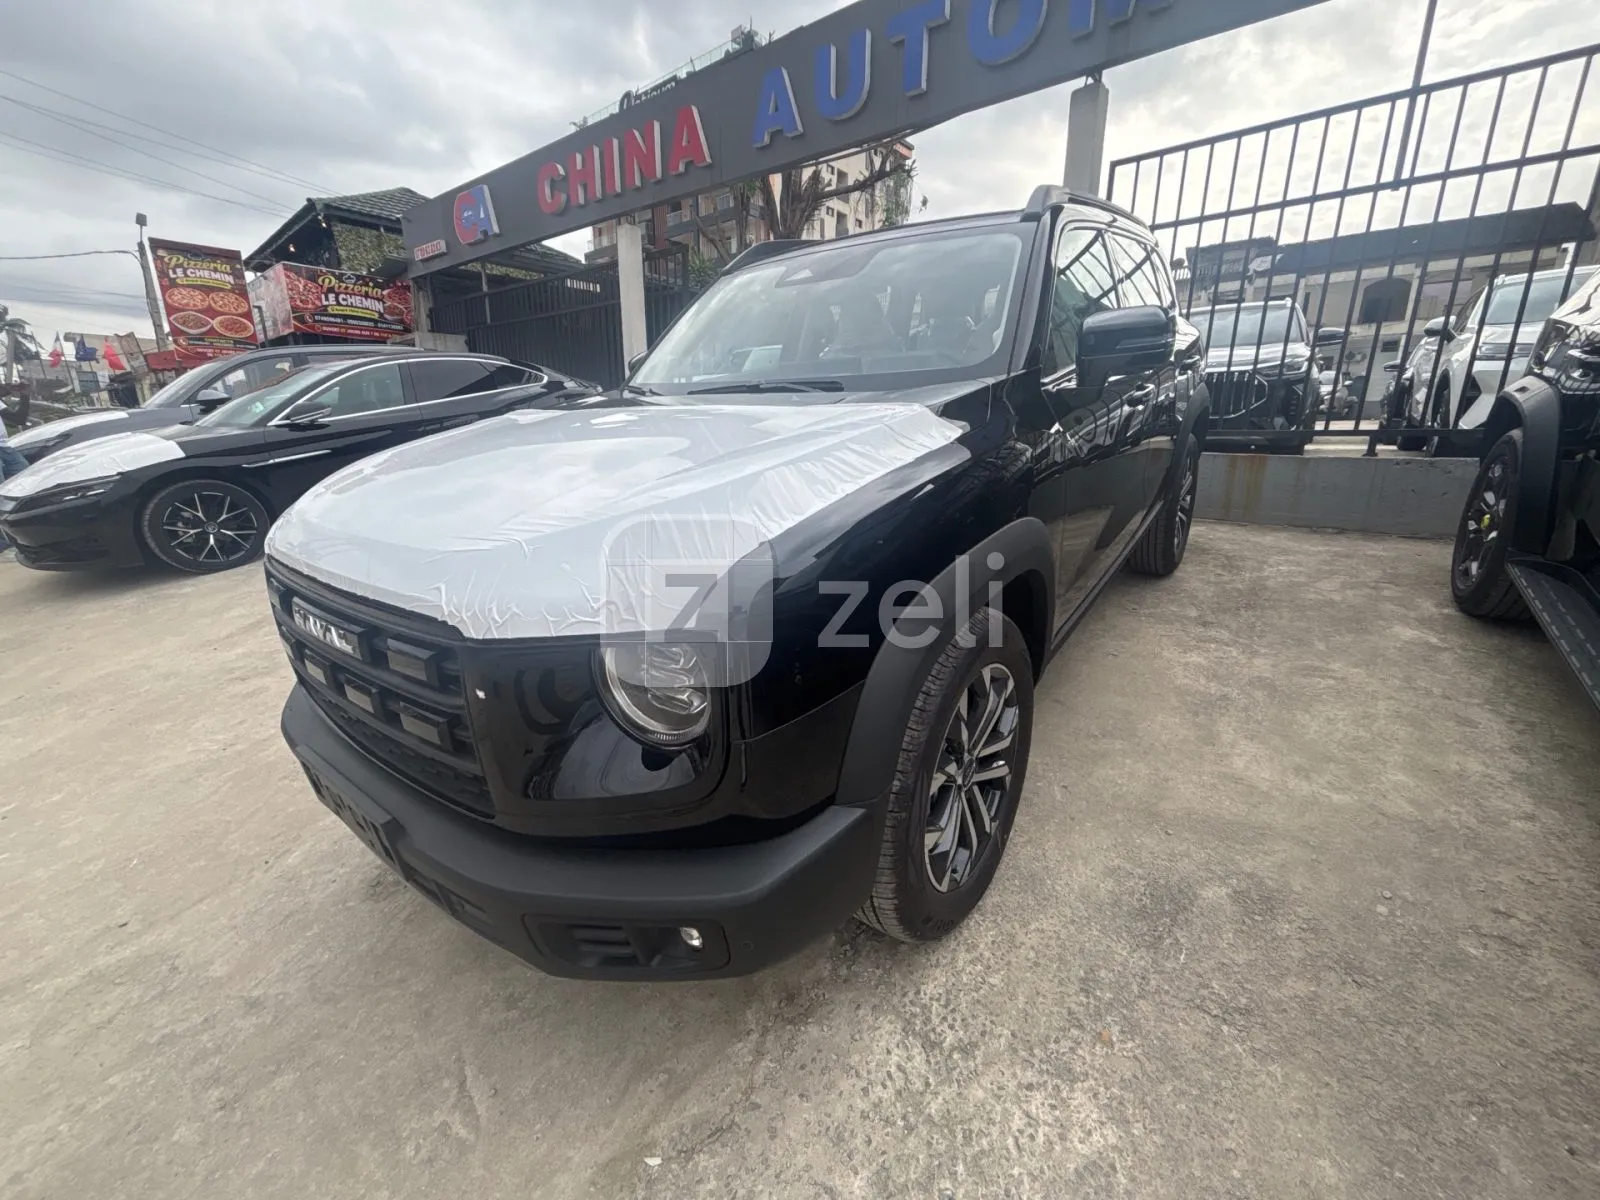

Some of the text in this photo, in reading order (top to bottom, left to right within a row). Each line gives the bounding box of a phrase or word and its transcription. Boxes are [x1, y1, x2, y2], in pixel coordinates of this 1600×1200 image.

[537, 104, 712, 214] CHINA
[168, 268, 185, 278] LE
[186, 268, 234, 285] CHEMIN
[321, 293, 336, 306] LE
[338, 293, 384, 314] CHEMIN
